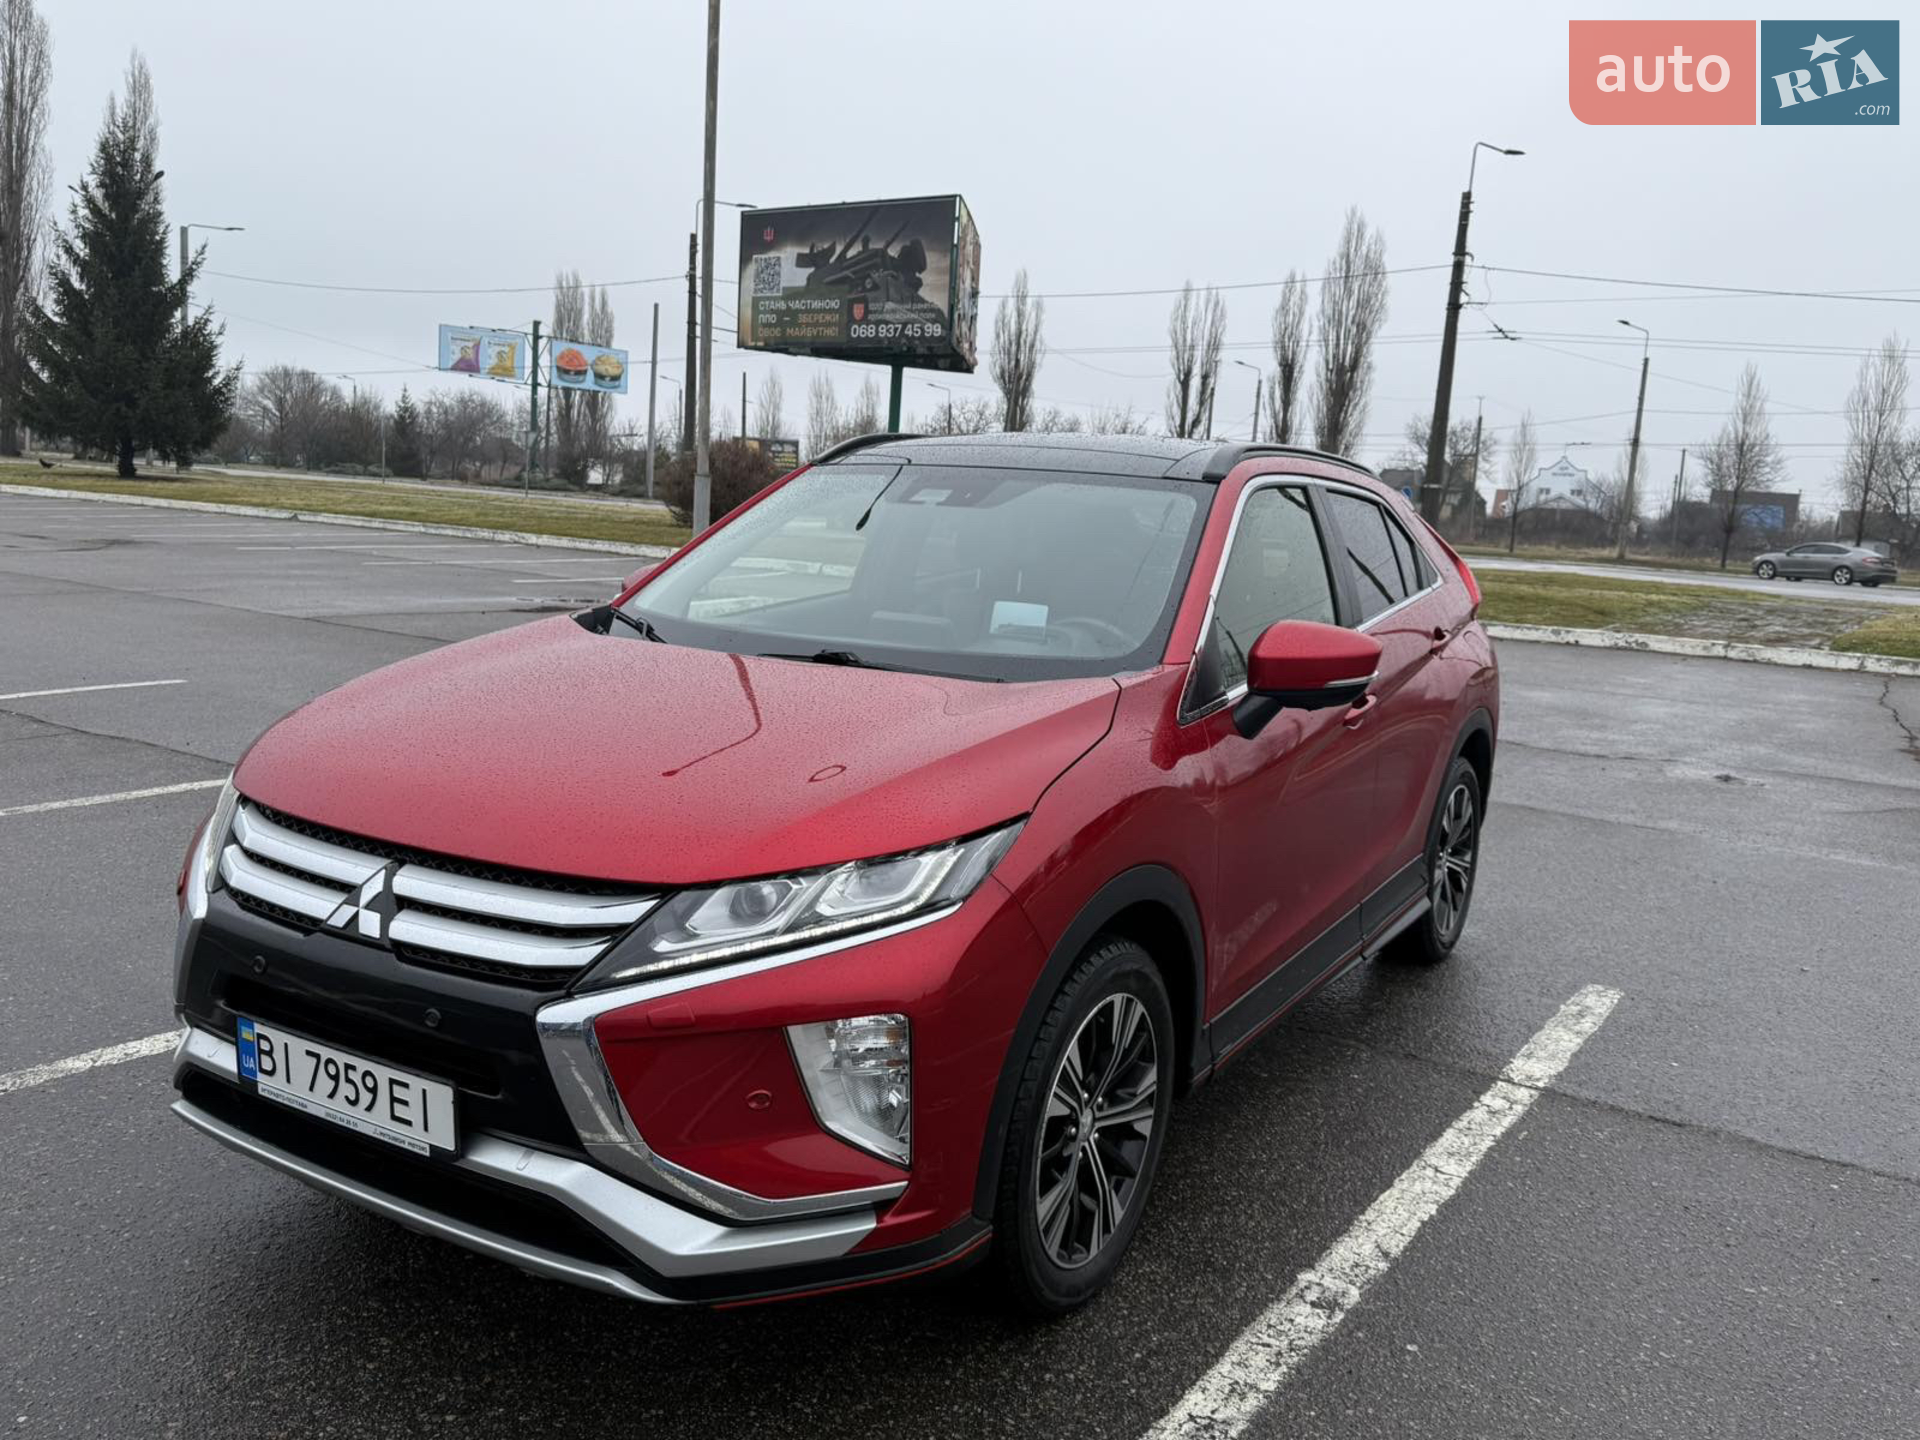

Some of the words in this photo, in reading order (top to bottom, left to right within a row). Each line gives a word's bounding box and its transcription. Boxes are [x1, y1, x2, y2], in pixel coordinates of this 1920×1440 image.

[758, 300, 787, 311] СТАНЬ
[787, 299, 840, 310] ЧАСТИНОЮ
[758, 313, 777, 324] ППО
[798, 312, 840, 324] ЗБЕРЕЖИ
[850, 324, 876, 338] 068
[878, 324, 902, 338] 937
[904, 324, 921, 338] 45
[924, 323, 942, 337] 99
[242, 1054, 256, 1071] UA
[256, 1032, 291, 1085] BI
[305, 1049, 379, 1112] 7959
[388, 1077, 429, 1133] EI
